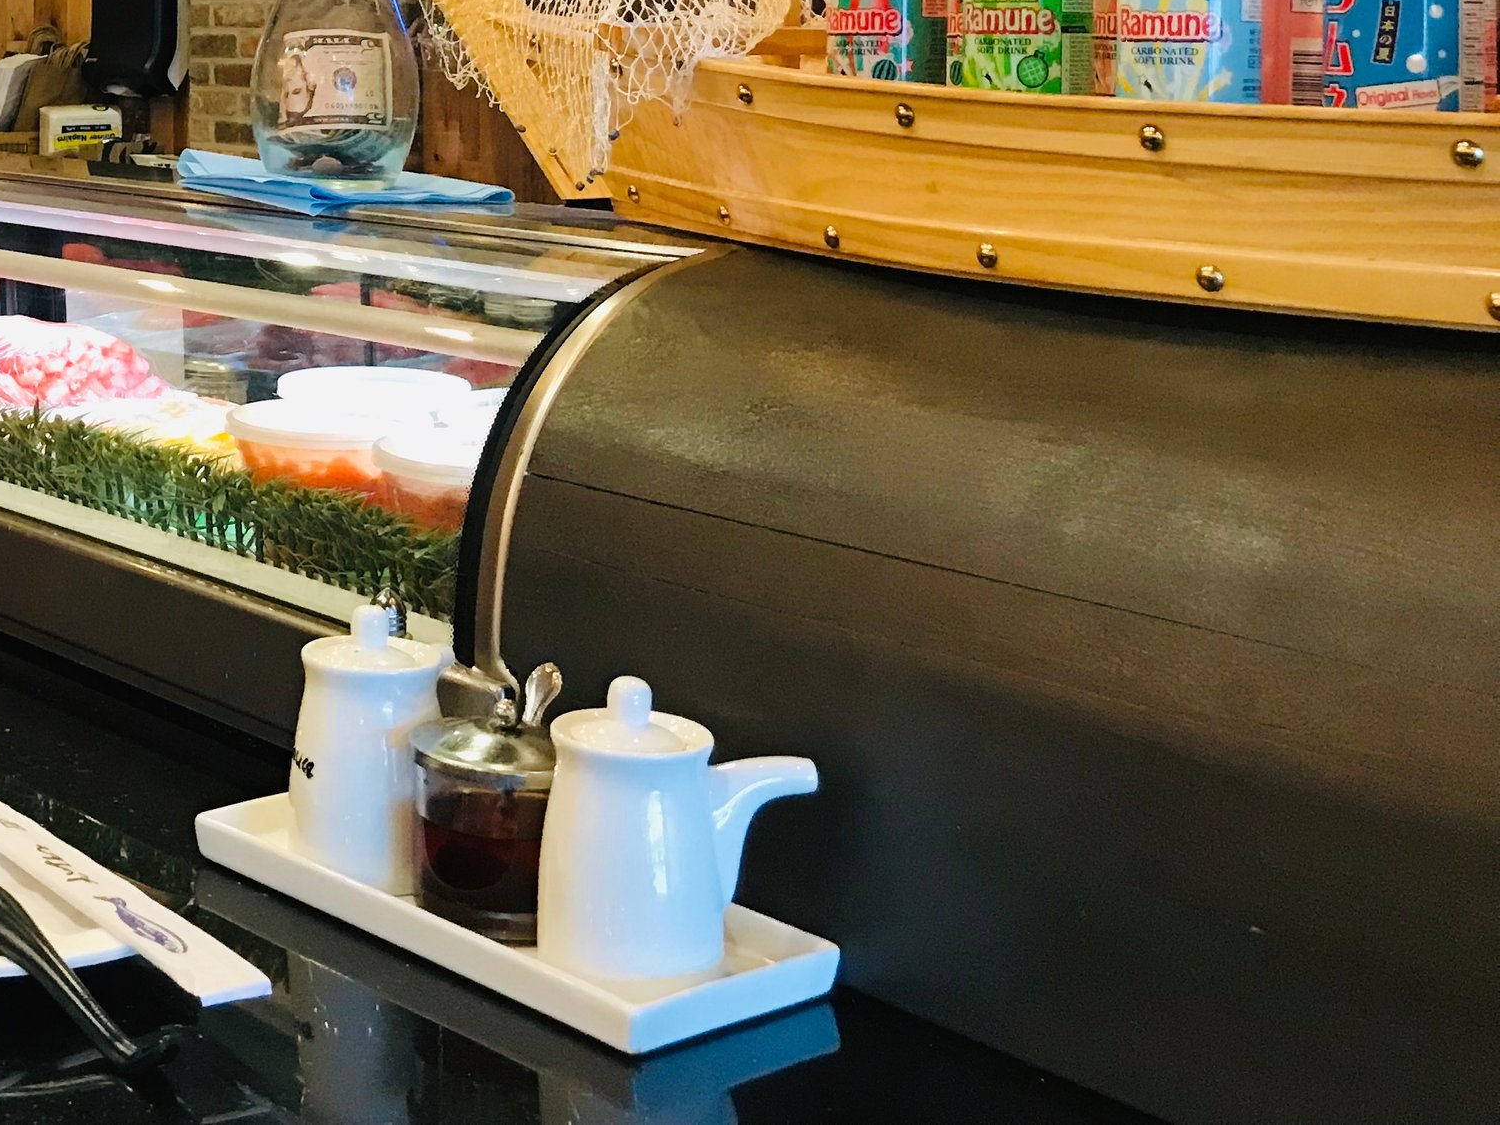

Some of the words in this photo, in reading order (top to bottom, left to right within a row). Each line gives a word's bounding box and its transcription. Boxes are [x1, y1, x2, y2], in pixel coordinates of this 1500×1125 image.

[963, 2, 1053, 32] Ramune
[1121, 8, 1218, 37] Ramune
[974, 37, 1032, 46] CARBONATED
[998, 46, 1028, 54] DRINK
[1131, 46, 1199, 56] CARBONATED
[1134, 57, 1156, 65] SOFT
[1160, 56, 1195, 65] DRINK
[1358, 86, 1409, 107] Original
